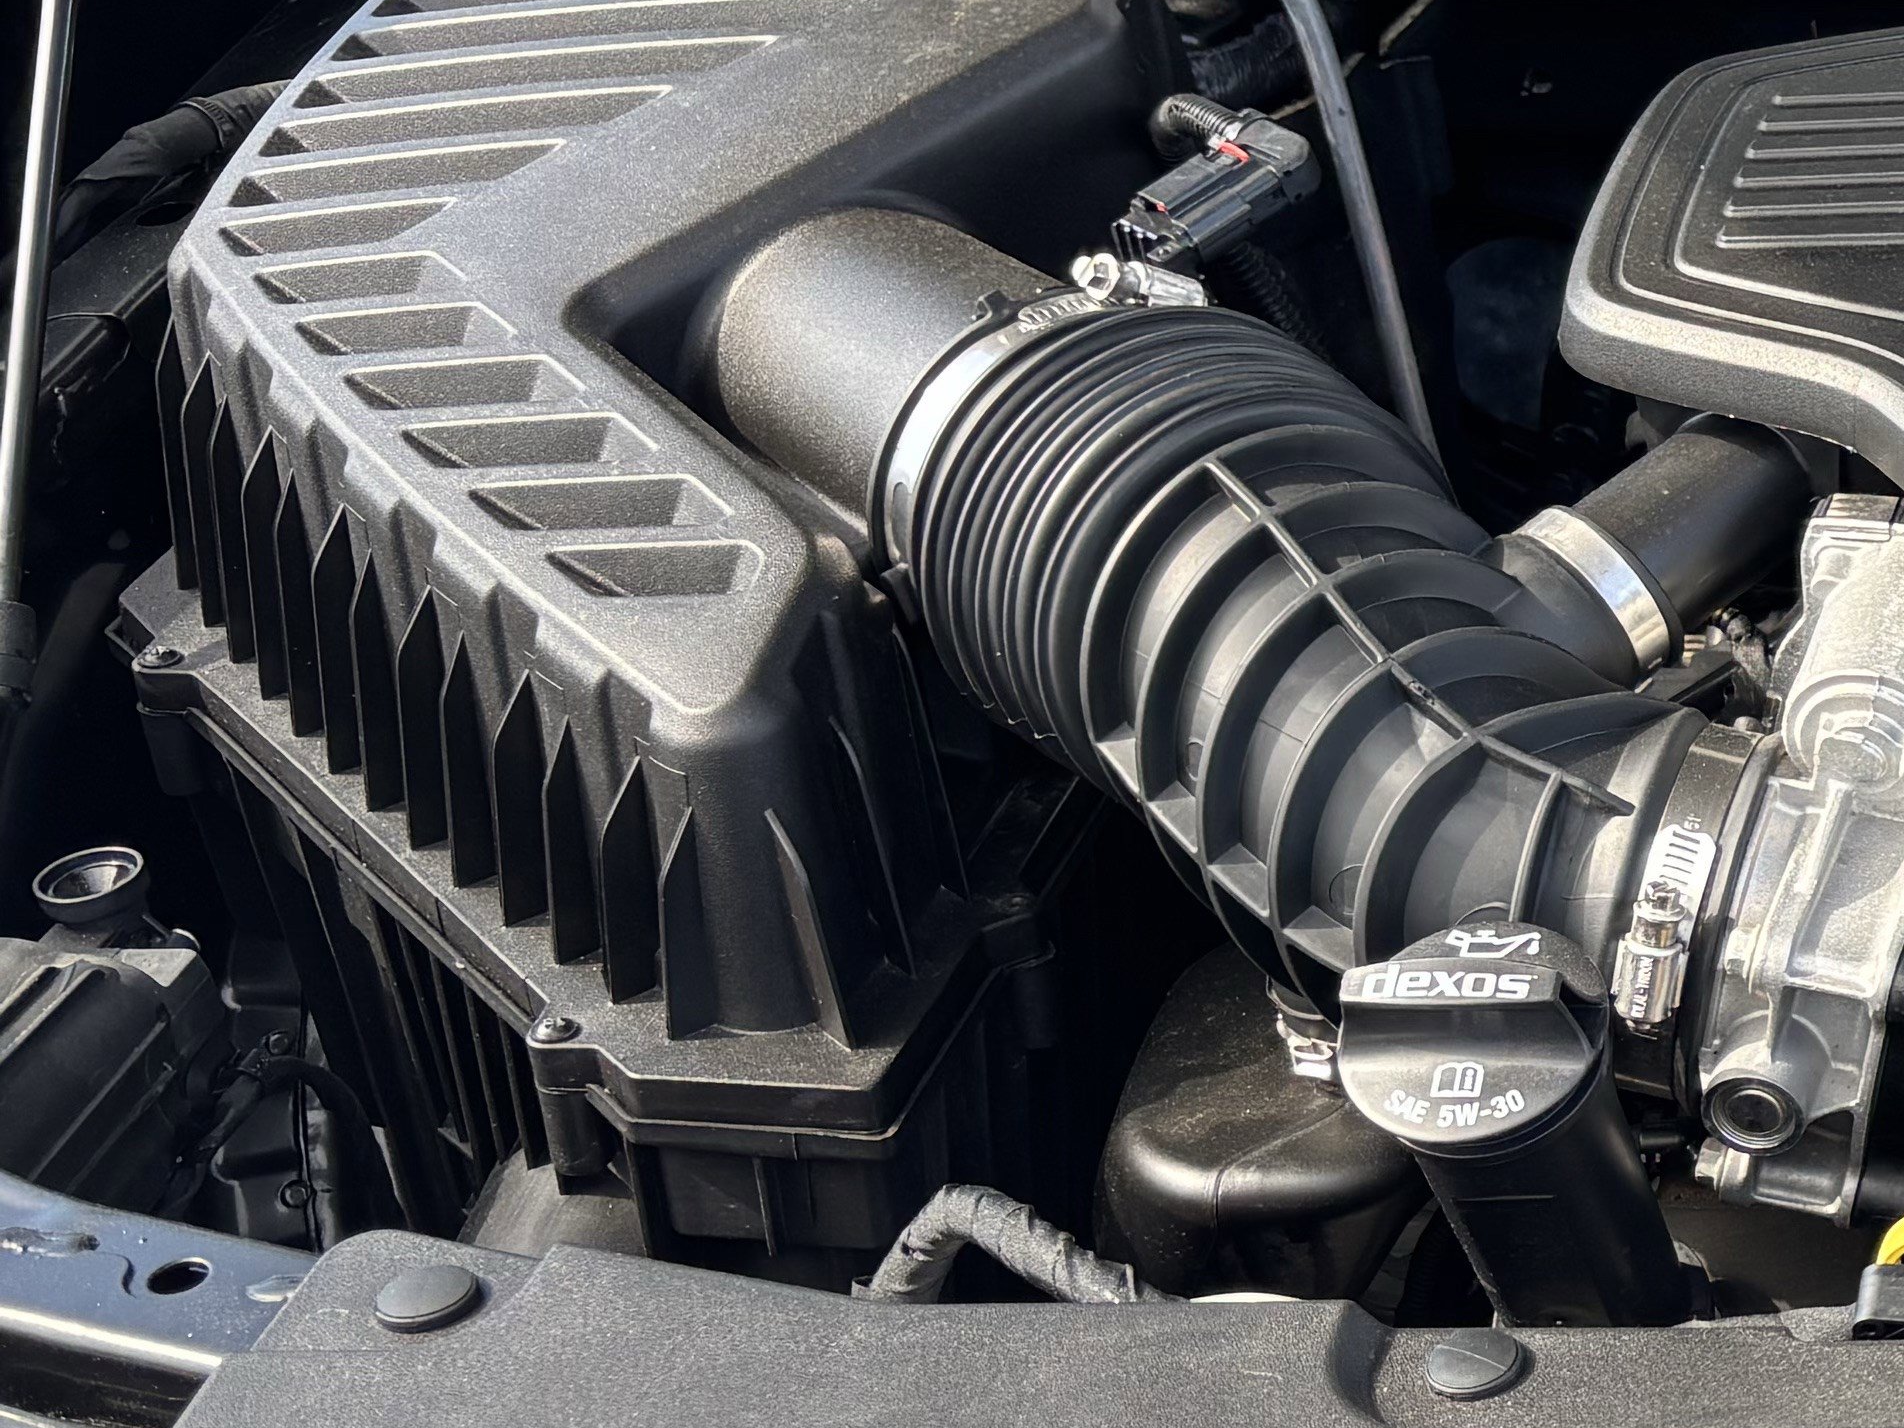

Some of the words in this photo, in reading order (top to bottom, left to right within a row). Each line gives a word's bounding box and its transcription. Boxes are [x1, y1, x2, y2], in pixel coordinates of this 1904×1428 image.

[1362, 964, 1531, 999] dexos
[1383, 1089, 1431, 1124] SAE
[1436, 1089, 1526, 1128] 5W-30
